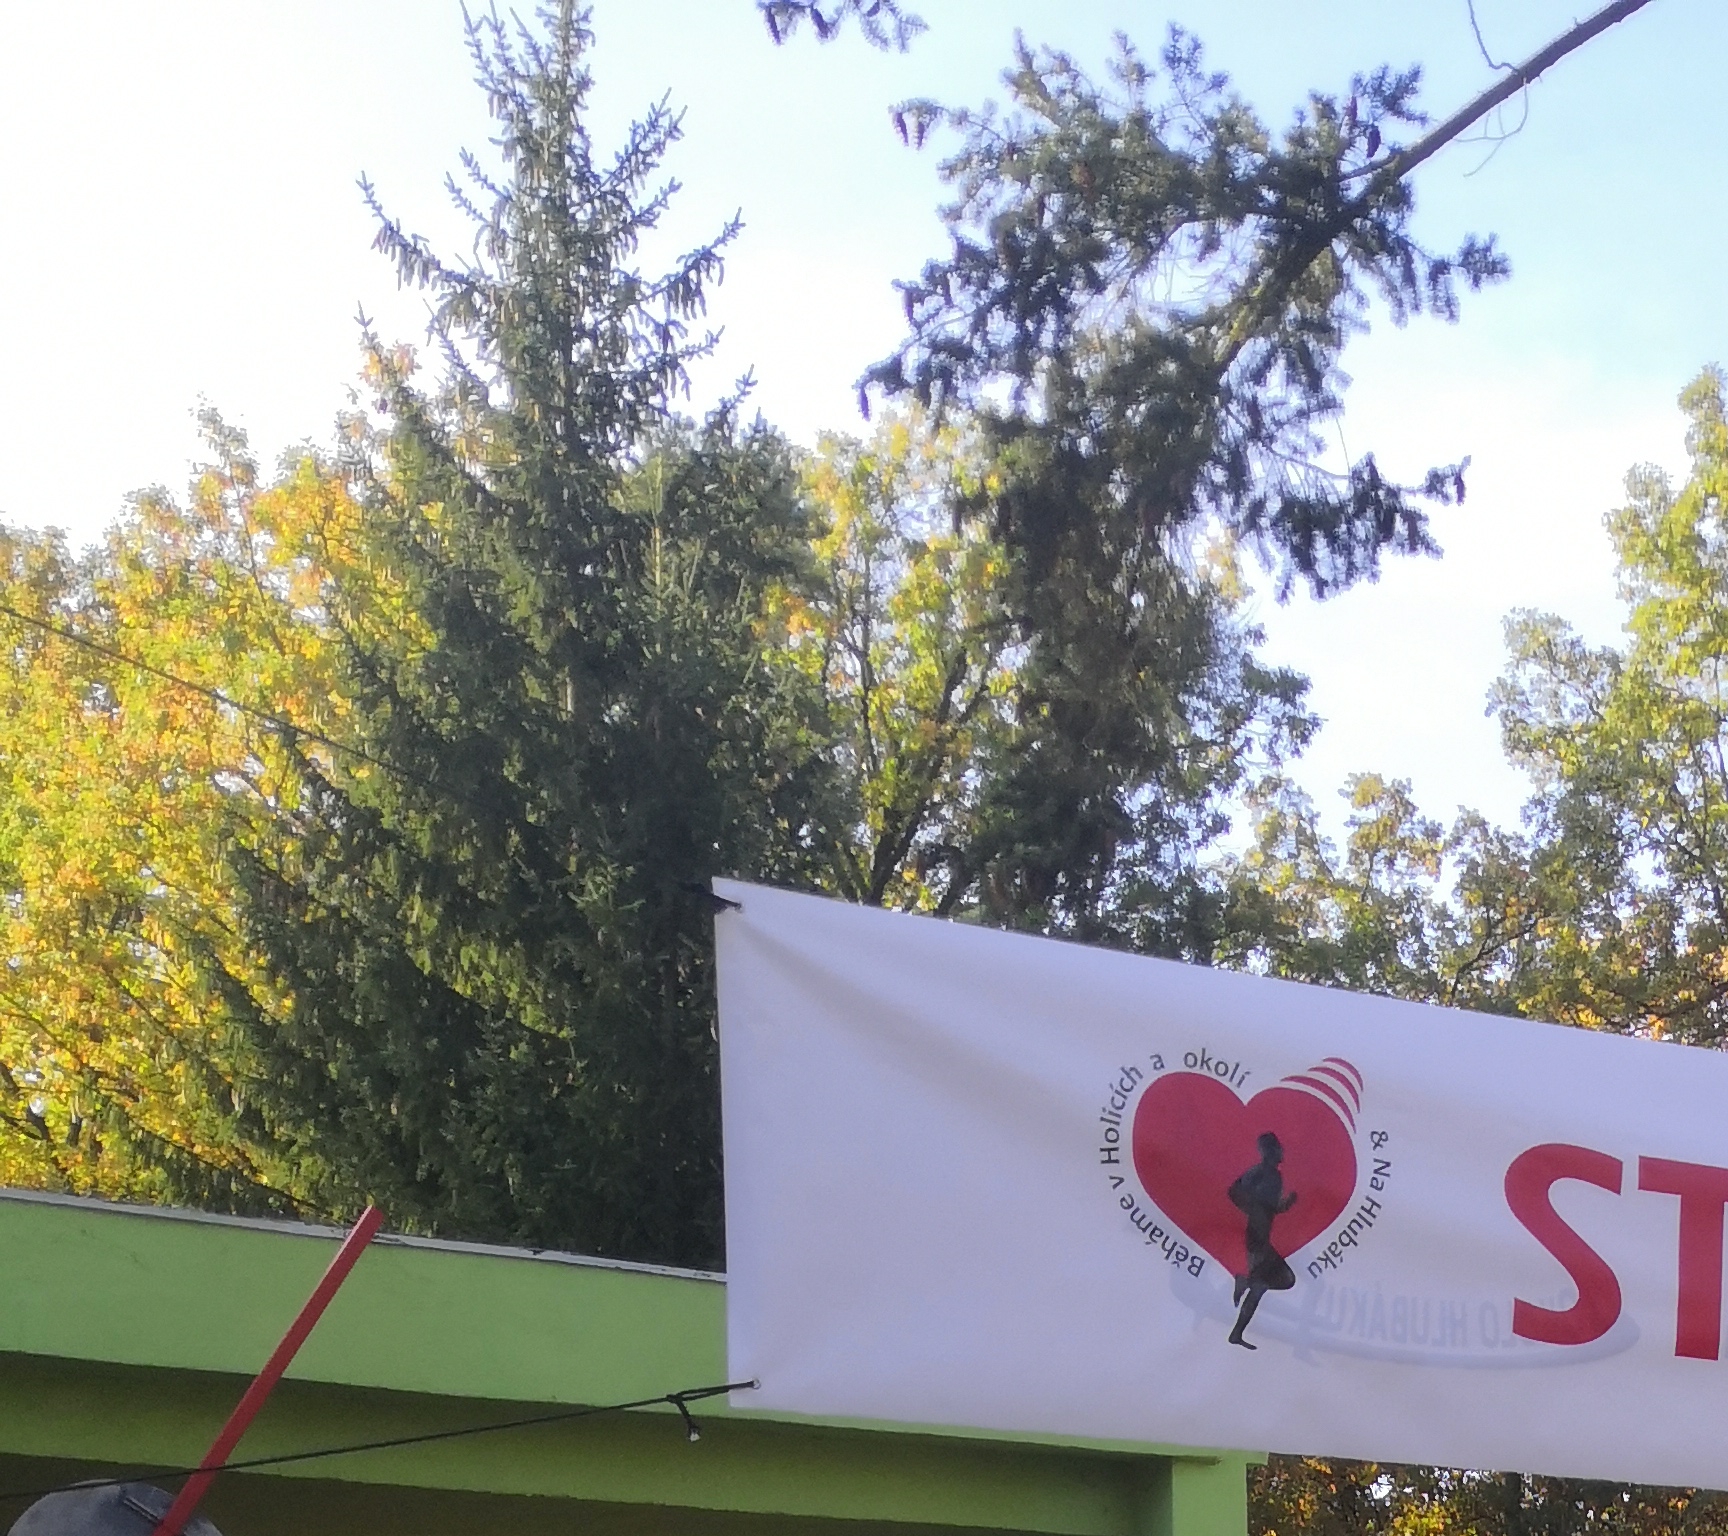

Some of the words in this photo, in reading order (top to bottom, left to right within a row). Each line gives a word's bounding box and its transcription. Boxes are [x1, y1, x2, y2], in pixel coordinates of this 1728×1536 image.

[1150, 1053, 1165, 1071] a
[1183, 1048, 1252, 1088] okolí
[1108, 1174, 1125, 1190] v
[1369, 1159, 1392, 1192] Na
[1119, 1193, 1205, 1278] Běháme
[1307, 1196, 1382, 1279] Hlubáku
